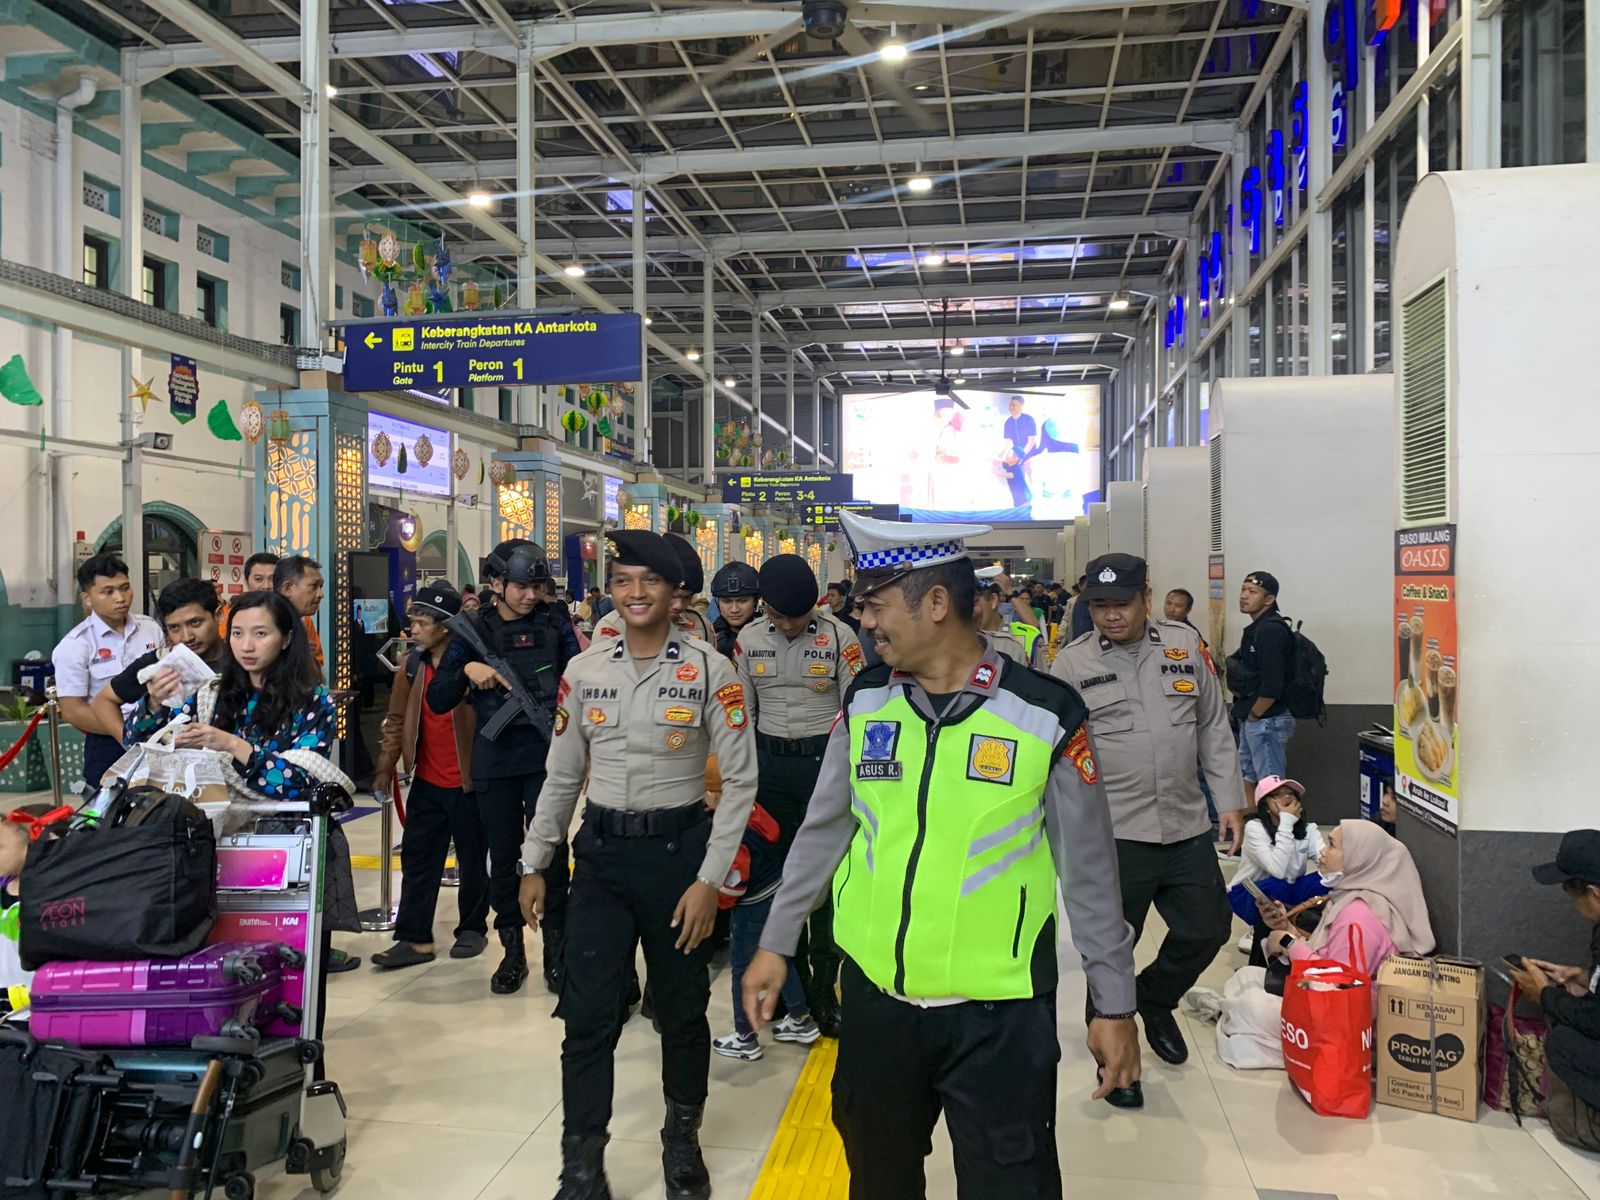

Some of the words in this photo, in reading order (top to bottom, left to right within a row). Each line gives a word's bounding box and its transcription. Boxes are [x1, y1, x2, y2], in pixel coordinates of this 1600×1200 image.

[421, 325, 511, 339] Keberangkatan
[513, 322, 533, 335] KA
[535, 320, 597, 333] Antarkota
[421, 341, 454, 351] Intercity
[457, 340, 477, 349] Train
[479, 338, 525, 349] Departures
[393, 361, 425, 374] Pintu
[433, 361, 443, 383] 1
[468, 358, 504, 371] Peron
[513, 358, 523, 380] 1
[392, 376, 414, 386] Gate
[468, 373, 505, 383] Platform
[759, 491, 767, 501] 2
[1400, 534, 1418, 545] BASO
[1419, 530, 1450, 543] MALANG
[1402, 549, 1447, 567] OASIS
[1402, 585, 1421, 599] Coffee
[1428, 585, 1448, 600] Snack
[804, 649, 836, 661] POLRI
[1160, 664, 1194, 675] POLRI
[658, 686, 703, 701] POLRI
[859, 764, 884, 777] AGUS
[888, 763, 899, 775] R.
[282, 916, 299, 926] KAI
[1393, 967, 1421, 978] JANGAN
[1424, 1012, 1447, 1021] BRU
[1391, 1040, 1457, 1062] PROMAG
[1391, 1080, 1420, 1090] Content
